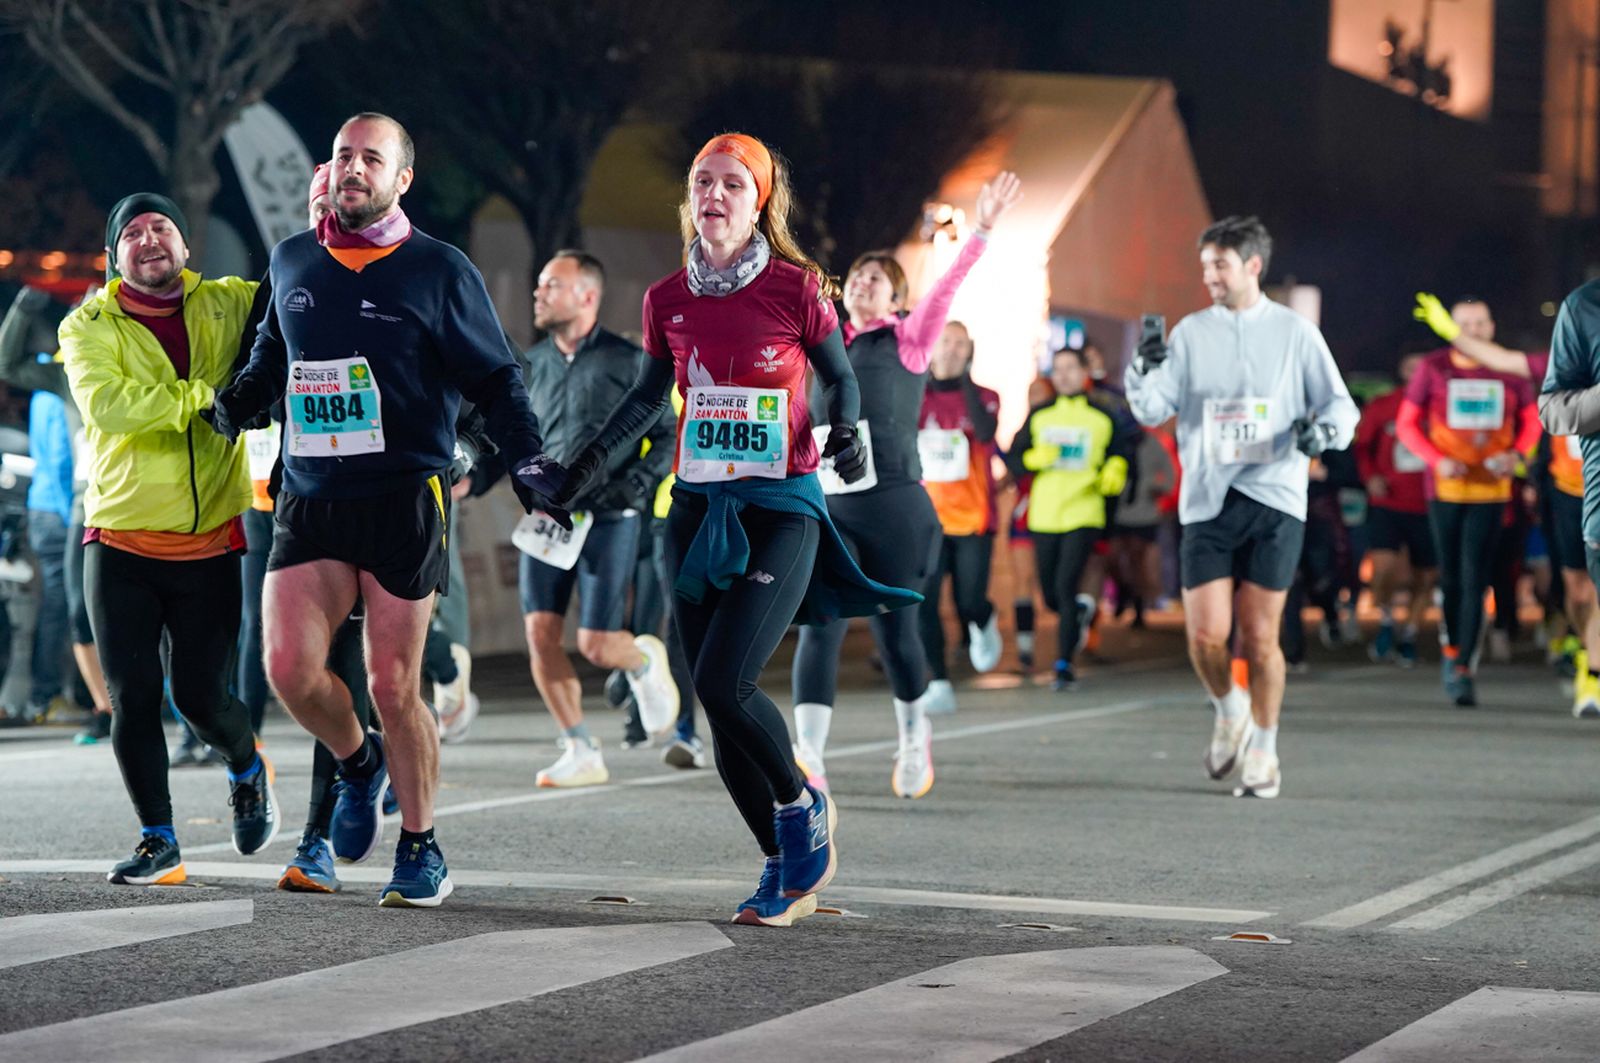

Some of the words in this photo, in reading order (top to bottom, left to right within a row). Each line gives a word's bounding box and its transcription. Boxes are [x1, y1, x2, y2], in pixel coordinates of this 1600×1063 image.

[304, 371, 325, 382] NOCHE
[327, 371, 340, 381] DE
[295, 384, 312, 394] SAN
[304, 392, 365, 423] 9484
[706, 397, 735, 408] NOCHE
[736, 398, 749, 408] DE
[695, 409, 711, 420] SAN
[712, 406, 748, 420] ANTÓN
[696, 421, 768, 452] 9485
